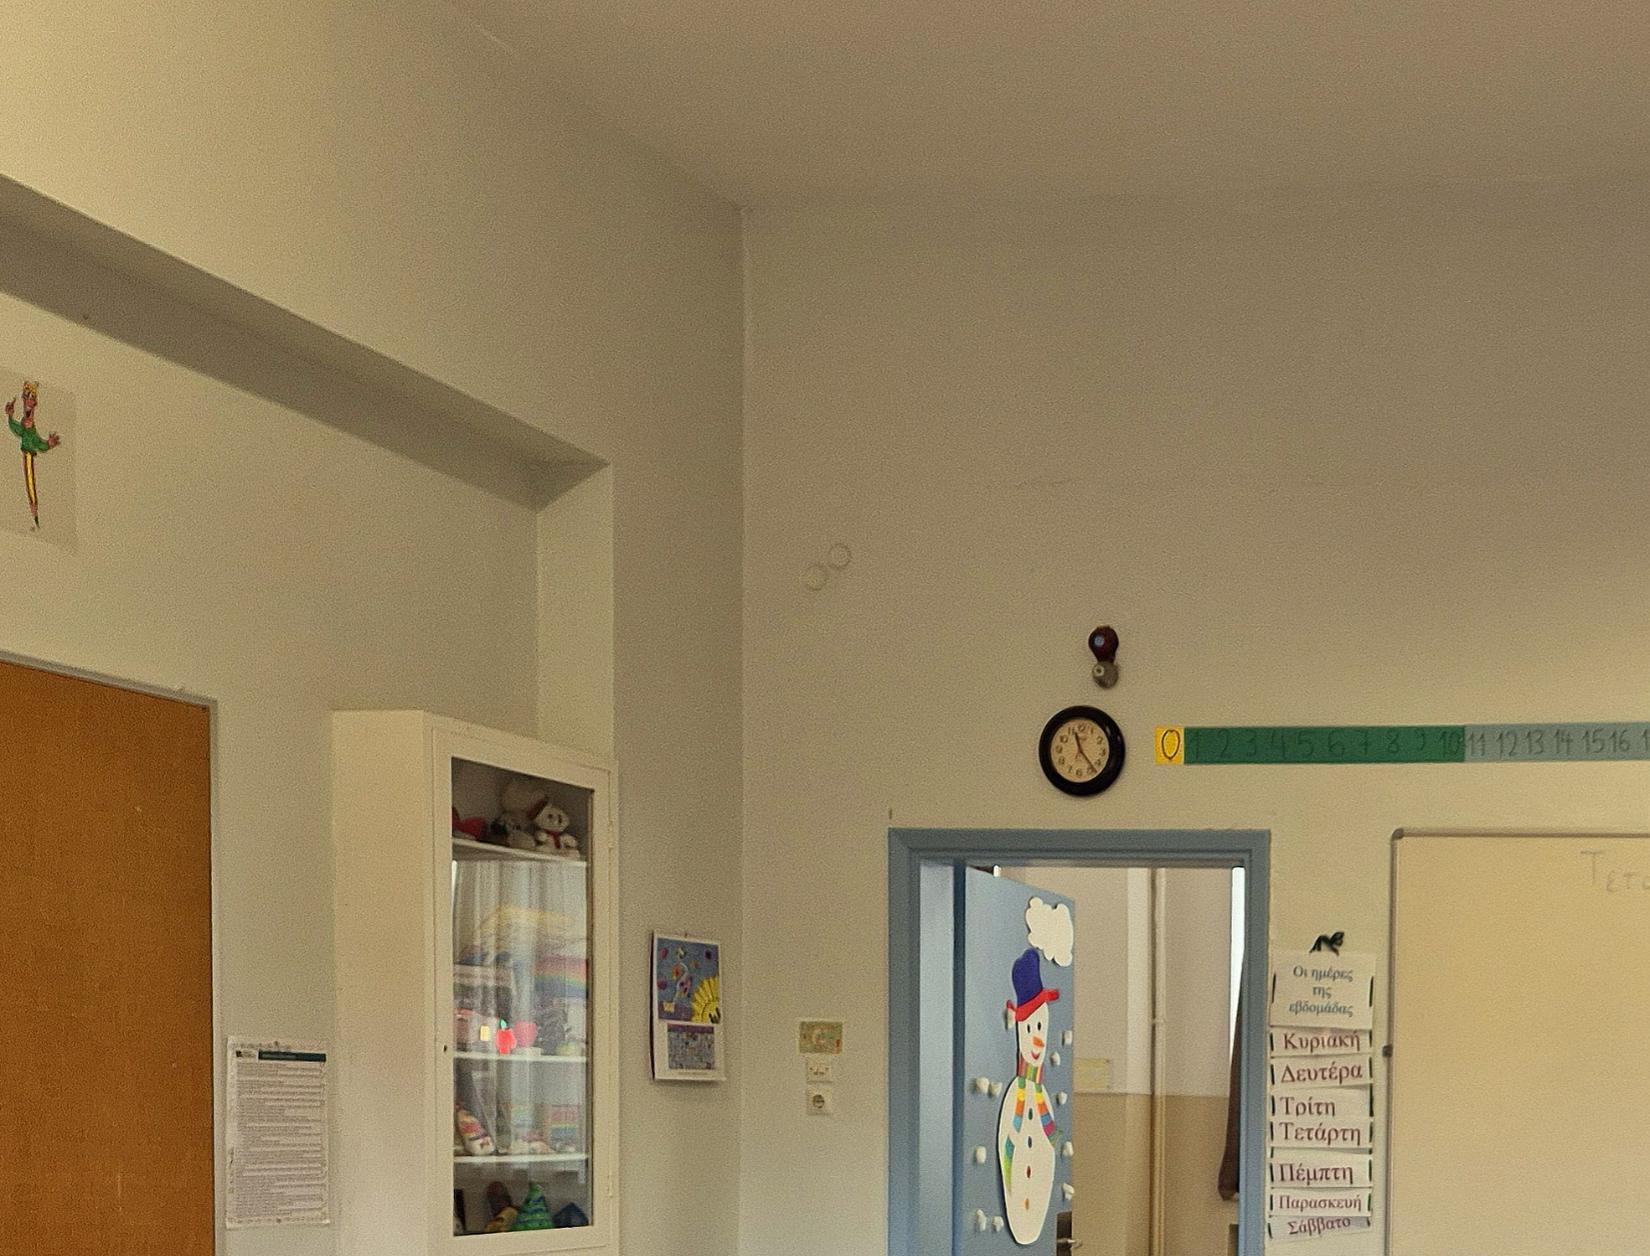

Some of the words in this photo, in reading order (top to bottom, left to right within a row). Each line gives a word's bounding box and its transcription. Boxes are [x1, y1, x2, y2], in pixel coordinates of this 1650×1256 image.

[1160, 729, 1181, 761] 0
[1190, 730, 1200, 759] 1
[1217, 729, 1232, 758] 2
[1244, 729, 1257, 757] 3
[1270, 730, 1287, 760] 4
[1297, 730, 1315, 758] 5
[1327, 729, 1346, 757] 6
[1357, 729, 1371, 755] 7
[1386, 729, 1400, 754] 8
[1413, 730, 1427, 751] 9
[1439, 730, 1461, 757] 10
[1468, 732, 1486, 757] 11
[1496, 730, 1518, 757] 12
[1520, 729, 1545, 755] 13
[1553, 729, 1572, 755] 14
[1583, 728, 1606, 753] 15
[1610, 728, 1631, 753] 16
[1293, 965, 1308, 978] Οι
[1311, 964, 1354, 983] ημέρες
[1312, 984, 1332, 999] της
[1288, 1001, 1354, 1017] εβδομάδας
[1283, 1030, 1361, 1053] Κυριακή
[1280, 1061, 1363, 1084] Δευτέρα
[1280, 1095, 1336, 1118] Τρίτη
[1279, 1120, 1362, 1146] Τετάρτη
[1279, 1162, 1354, 1184] Πέμπτη
[1278, 1193, 1363, 1213] Παρασκευή
[1287, 1216, 1351, 1236] Σάββατο
